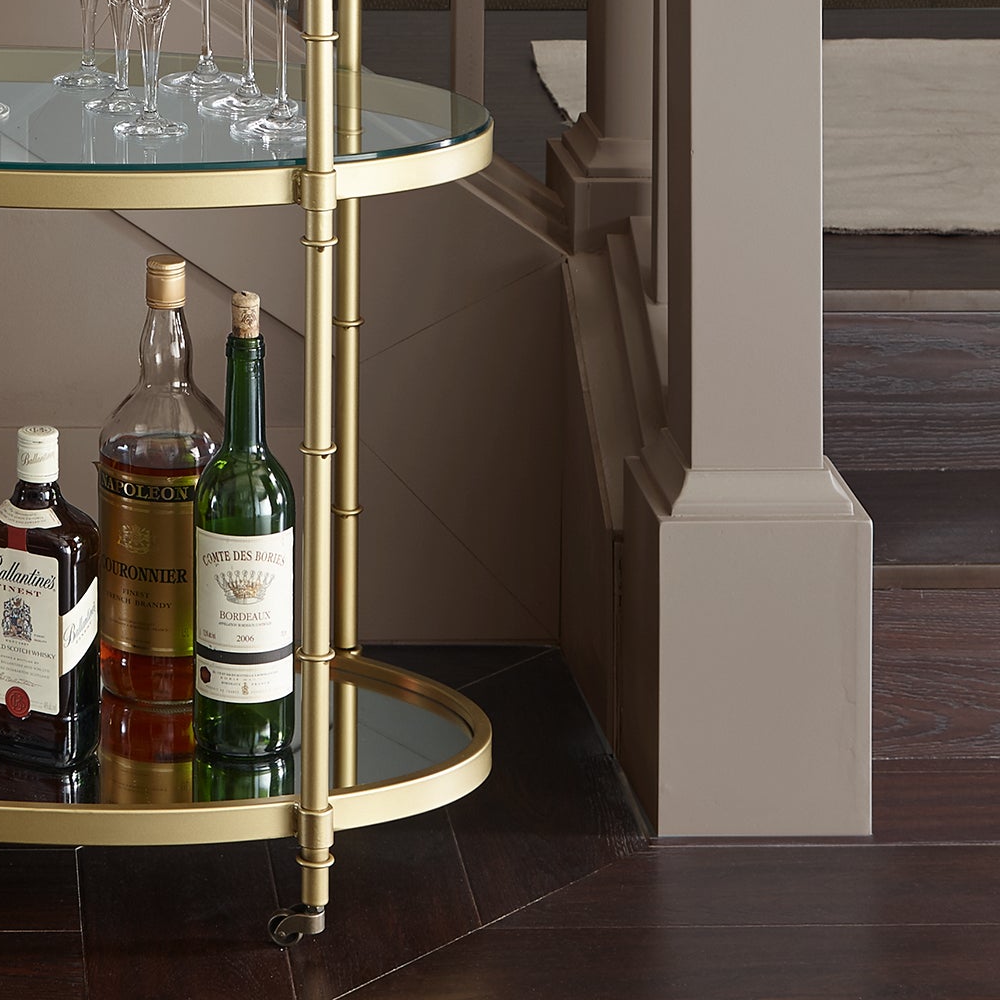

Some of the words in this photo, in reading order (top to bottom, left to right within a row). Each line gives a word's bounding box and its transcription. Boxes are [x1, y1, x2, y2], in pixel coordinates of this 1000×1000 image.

[101, 471, 189, 501] NAPOLEON
[202, 550, 231, 567] COMTE
[233, 550, 253, 562] DES
[255, 550, 286, 567] BORIES
[103, 556, 188, 584] OURONNIER
[122, 588, 150, 599] FINEST
[135, 599, 172, 609] BRANDY
[219, 610, 272, 621] BORDEAUX
[236, 634, 255, 643] 2006
[6, 645, 31, 656] SCOTCH
[31, 650, 57, 661] WHISKY
